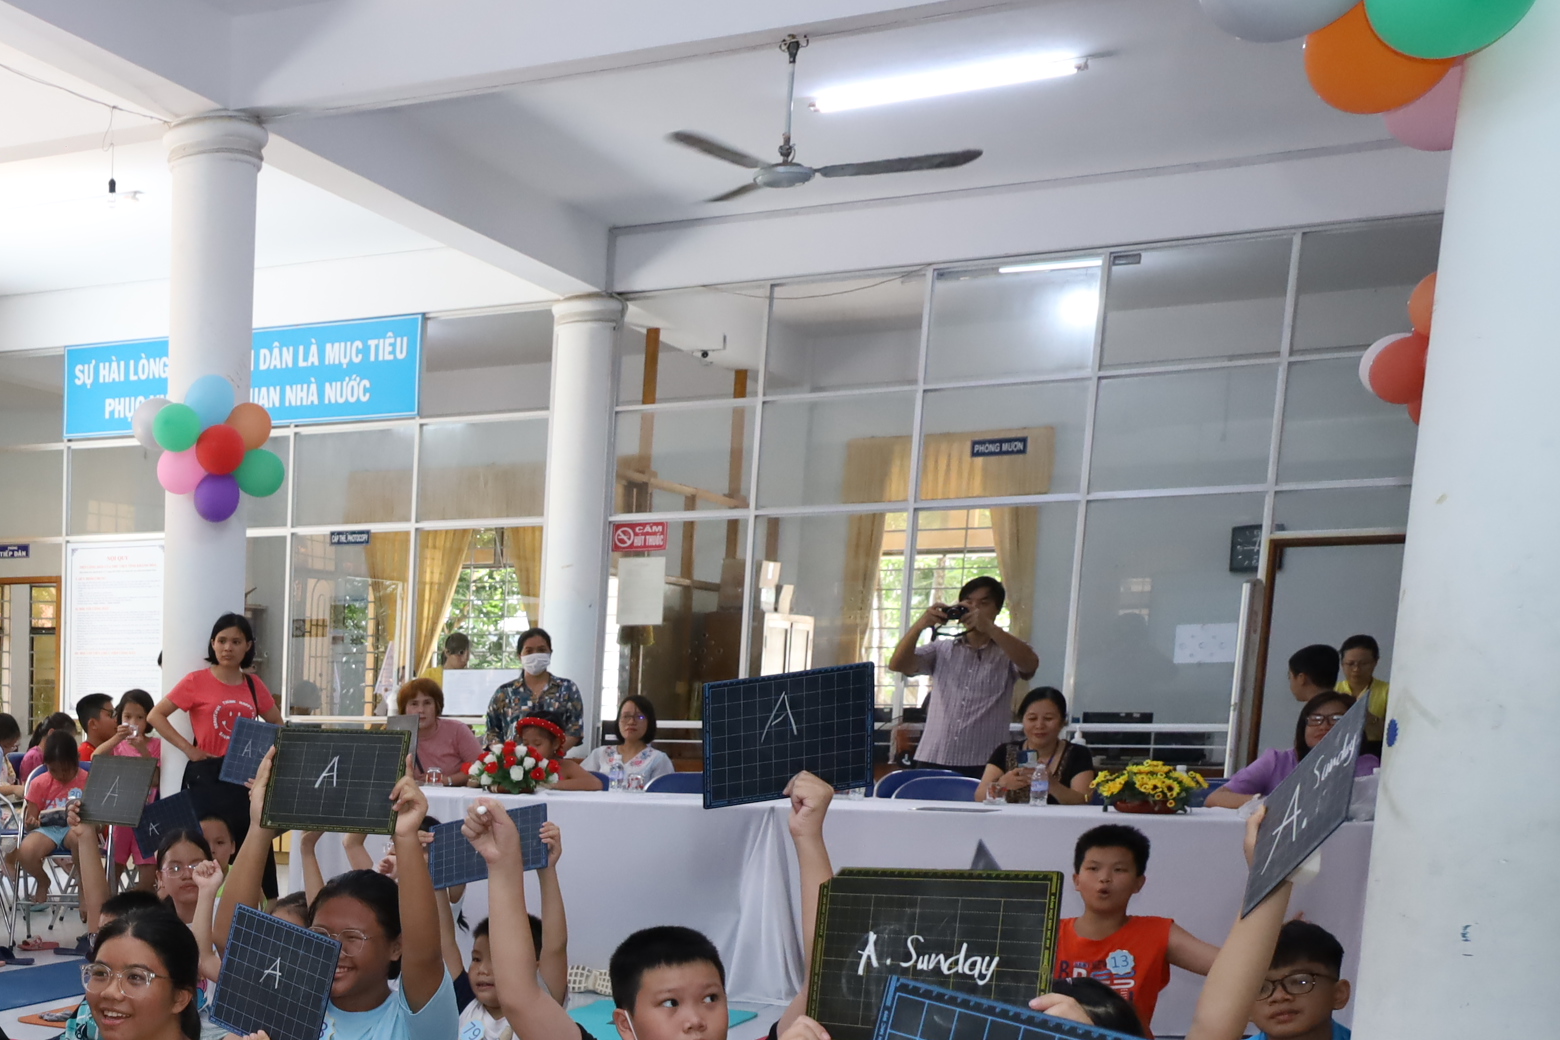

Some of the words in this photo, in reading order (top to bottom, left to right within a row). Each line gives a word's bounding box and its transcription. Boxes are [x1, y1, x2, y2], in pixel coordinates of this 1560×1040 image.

[74, 360, 95, 387] SỰ
[99, 357, 125, 384] HÀI
[129, 353, 169, 380] LÒNG
[259, 341, 293, 369] DÂN
[298, 338, 319, 367] LÀ
[325, 342, 363, 368] MỤC
[368, 332, 408, 361] TIÊU
[285, 378, 319, 406] NHÀ
[324, 375, 371, 404] NƯỚC
[973, 442, 1000, 454] PHÒNG
[1002, 440, 1024, 452] MƯỢN
[633, 534, 644, 546] HÚT
[645, 533, 664, 546] THUỐC
[635, 524, 662, 533] CẤM
[761, 691, 798, 743] A
[241, 738, 252, 758] A
[314, 754, 340, 789] A
[100, 775, 120, 807] A
[259, 957, 282, 989] A
[857, 931, 891, 976] A.
[900, 934, 1000, 986] Sunday
[1110, 954, 1129, 968] 13
[463, 1021, 482, 1040] 79
